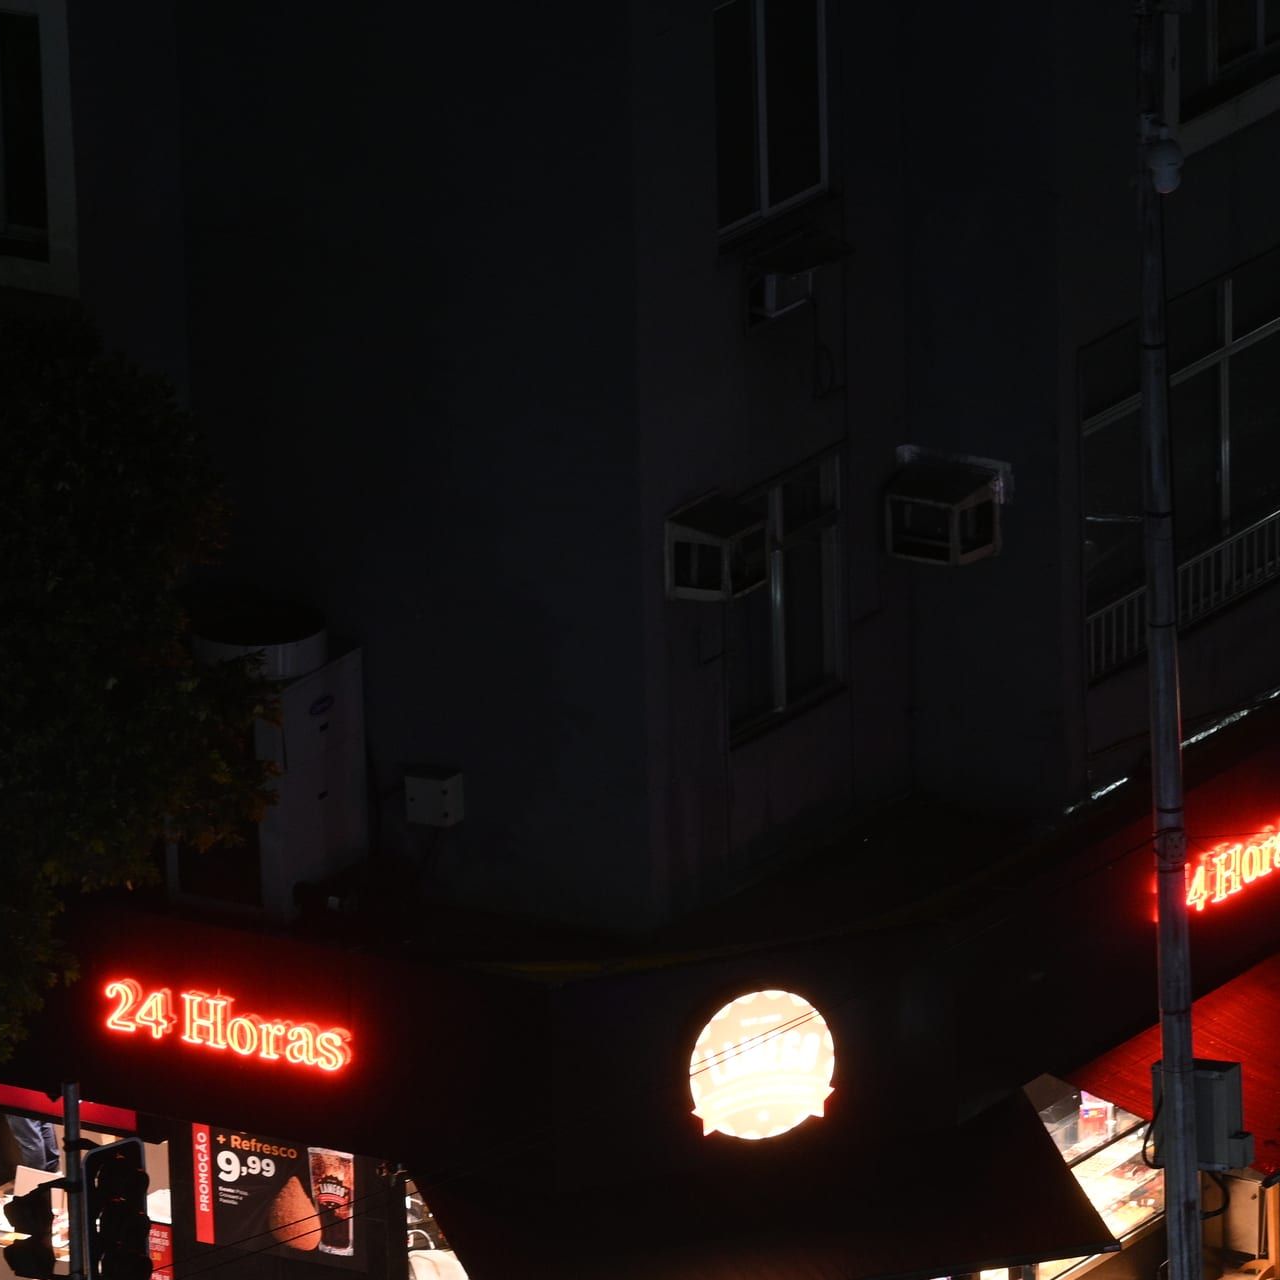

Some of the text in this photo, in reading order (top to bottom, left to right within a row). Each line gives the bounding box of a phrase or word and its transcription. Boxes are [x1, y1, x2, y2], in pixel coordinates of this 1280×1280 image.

[105, 982, 349, 1071] 24 Horas
[195, 1132, 210, 1212] PROMOÇÃO
[216, 1150, 276, 1183] 9,99
[230, 1135, 298, 1159] Refresco
